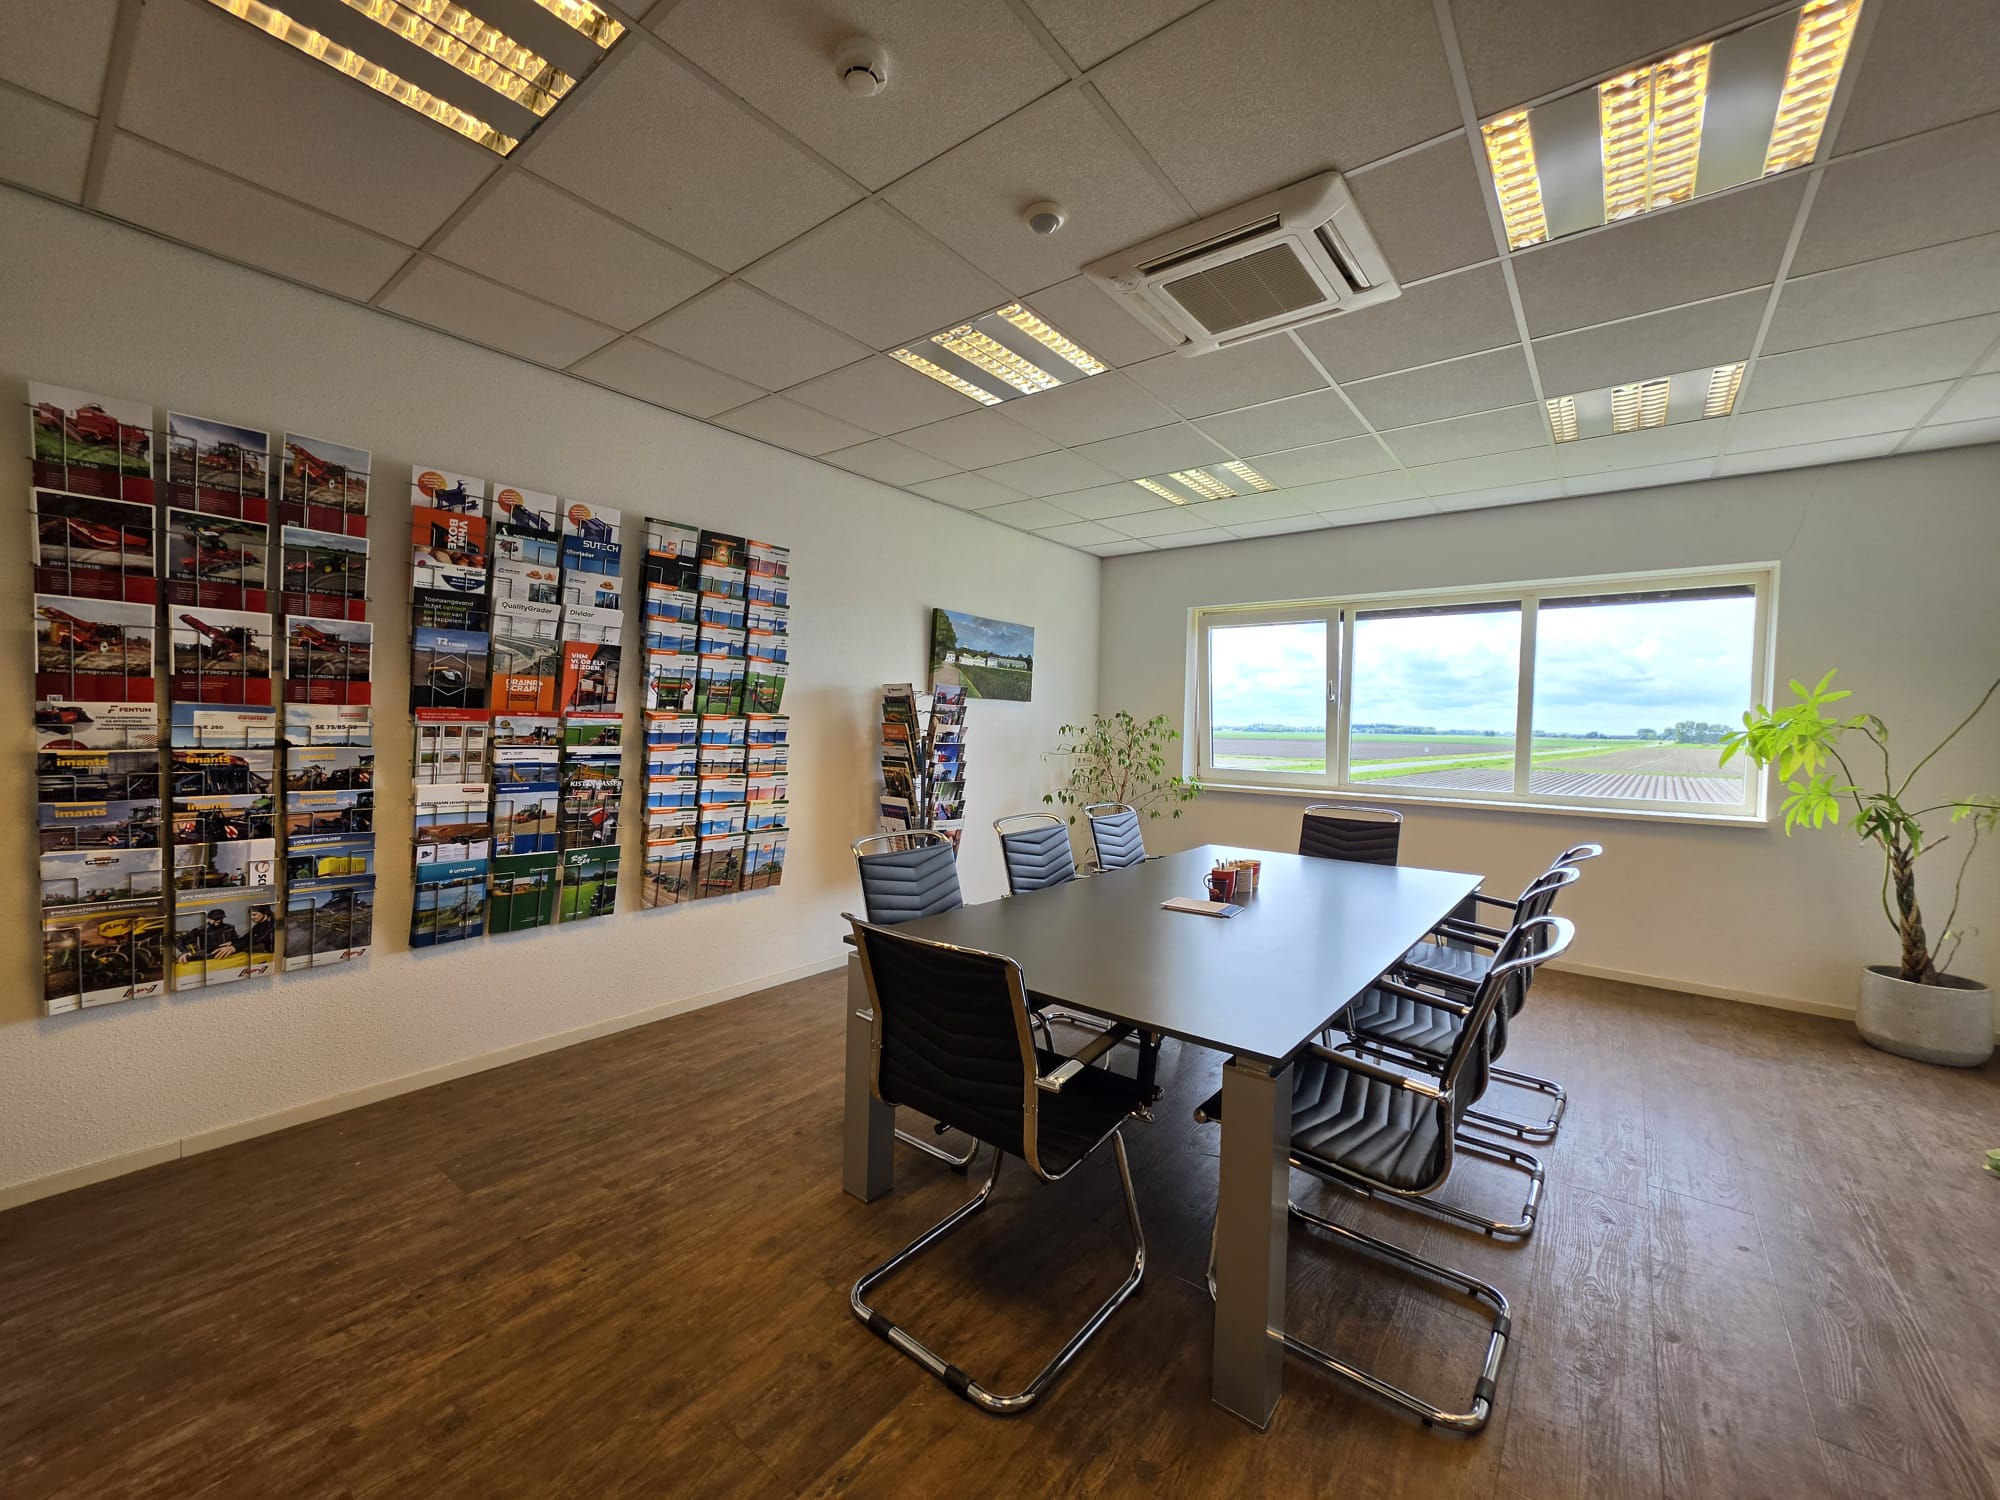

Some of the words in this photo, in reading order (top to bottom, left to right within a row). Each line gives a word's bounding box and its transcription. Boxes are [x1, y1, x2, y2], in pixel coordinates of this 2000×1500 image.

[583, 540, 619, 553] SUTECH
[501, 602, 552, 615] QualityGrader
[570, 609, 595, 618] Divider
[47, 668, 124, 676] Produtprogramma
[182, 668, 229, 676] VAITRON
[56, 758, 109, 767] imants
